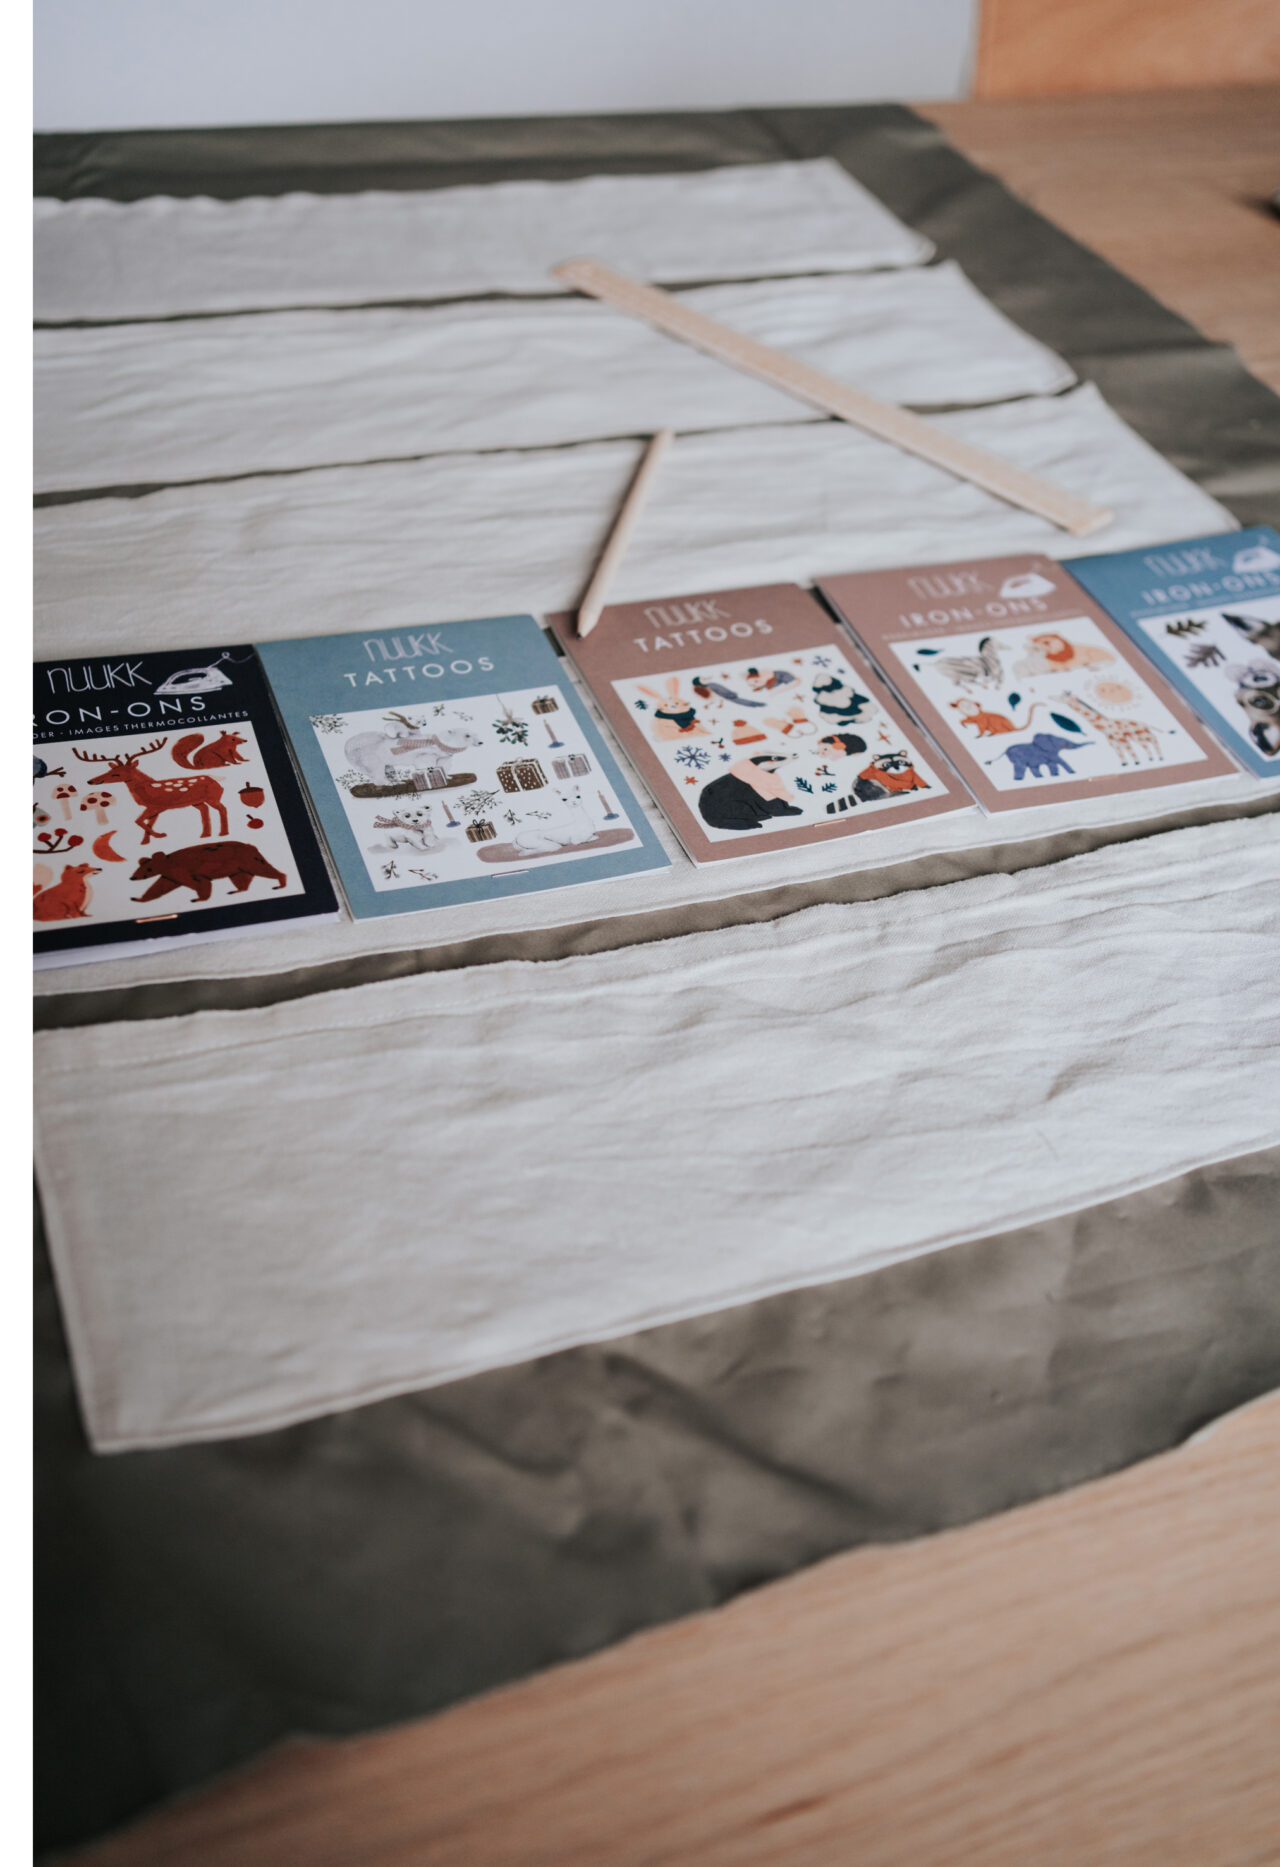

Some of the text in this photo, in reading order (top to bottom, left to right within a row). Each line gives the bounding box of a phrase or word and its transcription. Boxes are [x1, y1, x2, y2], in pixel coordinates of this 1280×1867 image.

[633, 619, 773, 653] TATTOOS
[343, 656, 495, 688] TATTOOS
[69, 724, 120, 735] IMAGES
[123, 710, 249, 730] THERMOCOLLANTES
